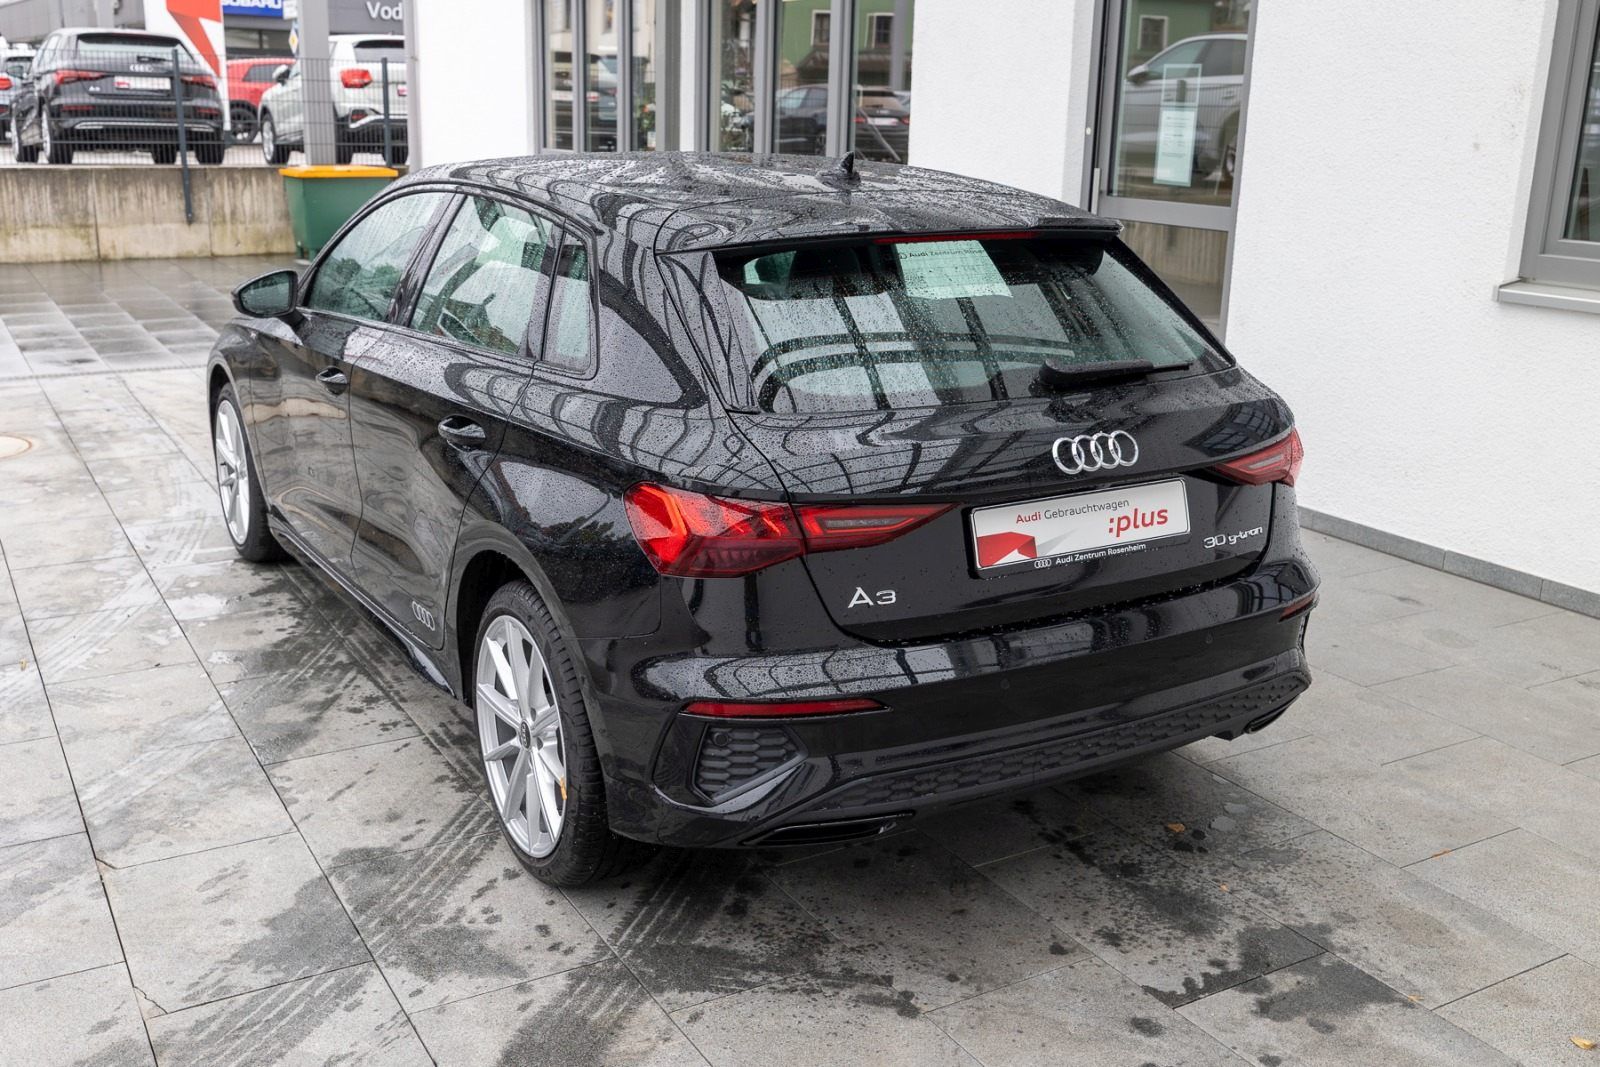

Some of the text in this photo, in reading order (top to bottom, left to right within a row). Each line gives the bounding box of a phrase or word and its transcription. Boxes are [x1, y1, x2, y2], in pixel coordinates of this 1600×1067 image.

[1016, 500, 1130, 524] Audi Gebrauchtwagen
[1203, 526, 1263, 549] 30 g-tron
[1055, 543, 1147, 565] Audi Zentrum Rosenheim
[847, 586, 897, 608] A3
